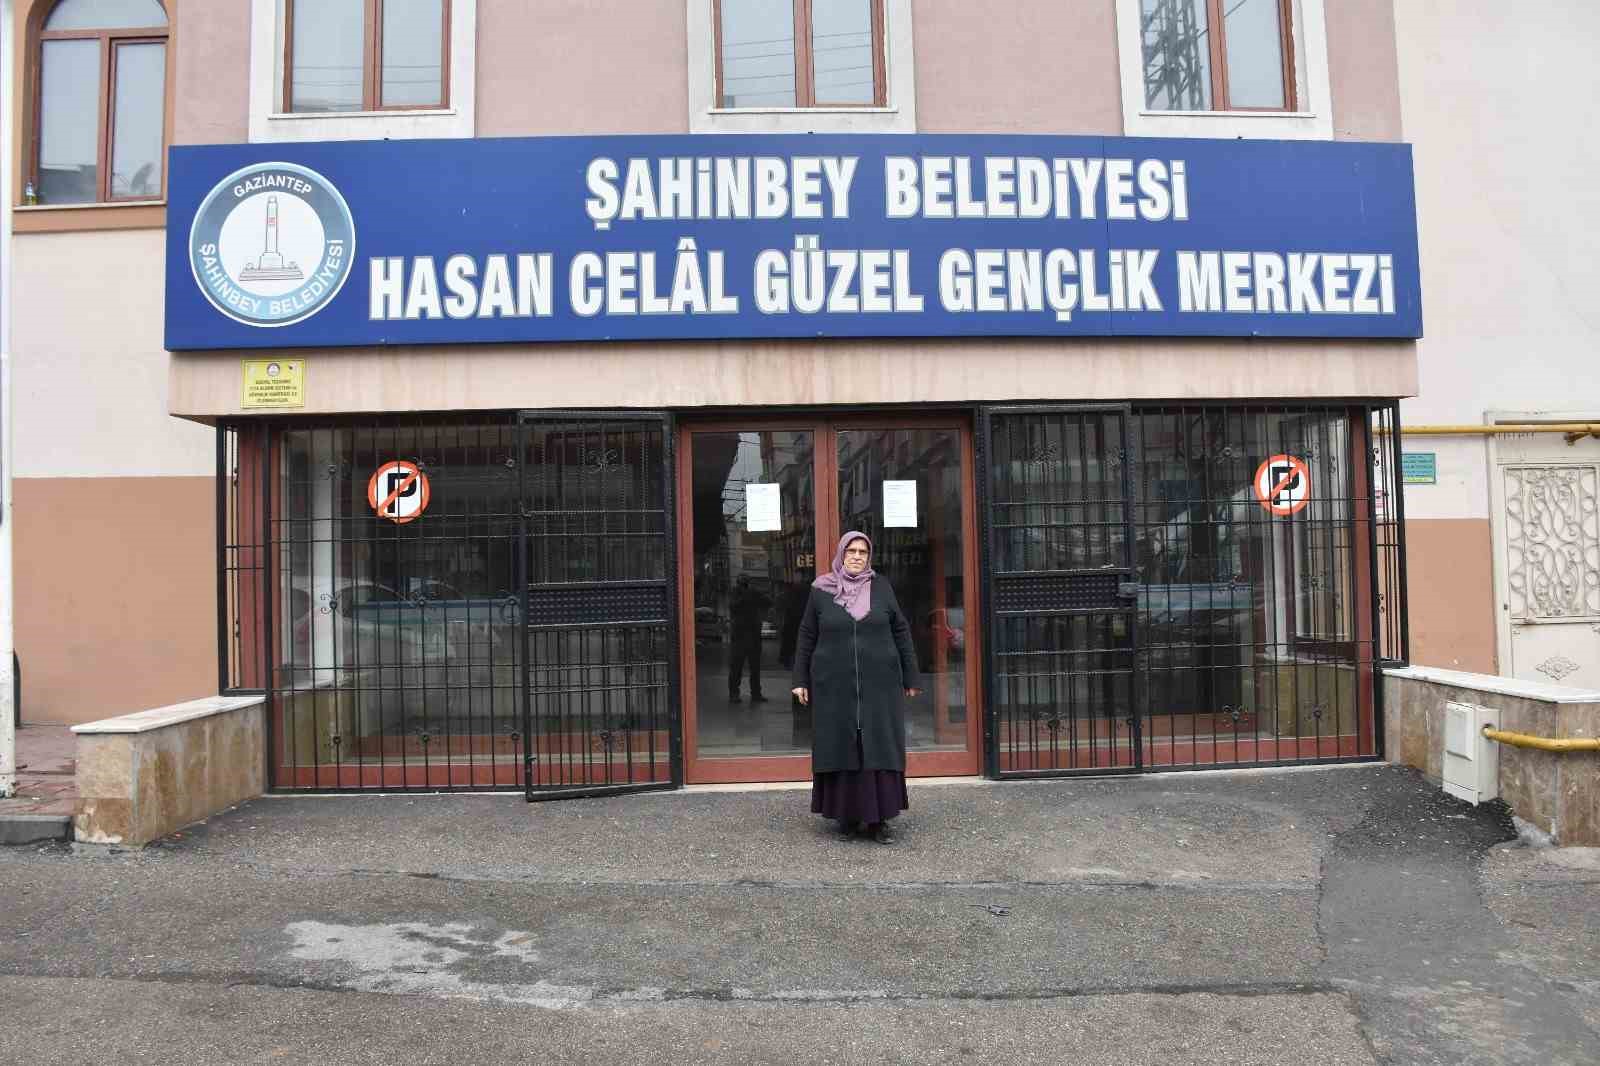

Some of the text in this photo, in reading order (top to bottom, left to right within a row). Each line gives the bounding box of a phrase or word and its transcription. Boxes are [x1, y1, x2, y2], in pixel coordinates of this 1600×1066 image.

[233, 173, 312, 198] GAZİANTEP
[586, 157, 1188, 230] ŞAHİNBEY BELEDİYESİ
[200, 239, 344, 314] ŞAHİNBEY BELEDİYESİ
[369, 235, 1396, 322] HASAN CELÂL GÜZEL GENÇLİK MERKEZİ
